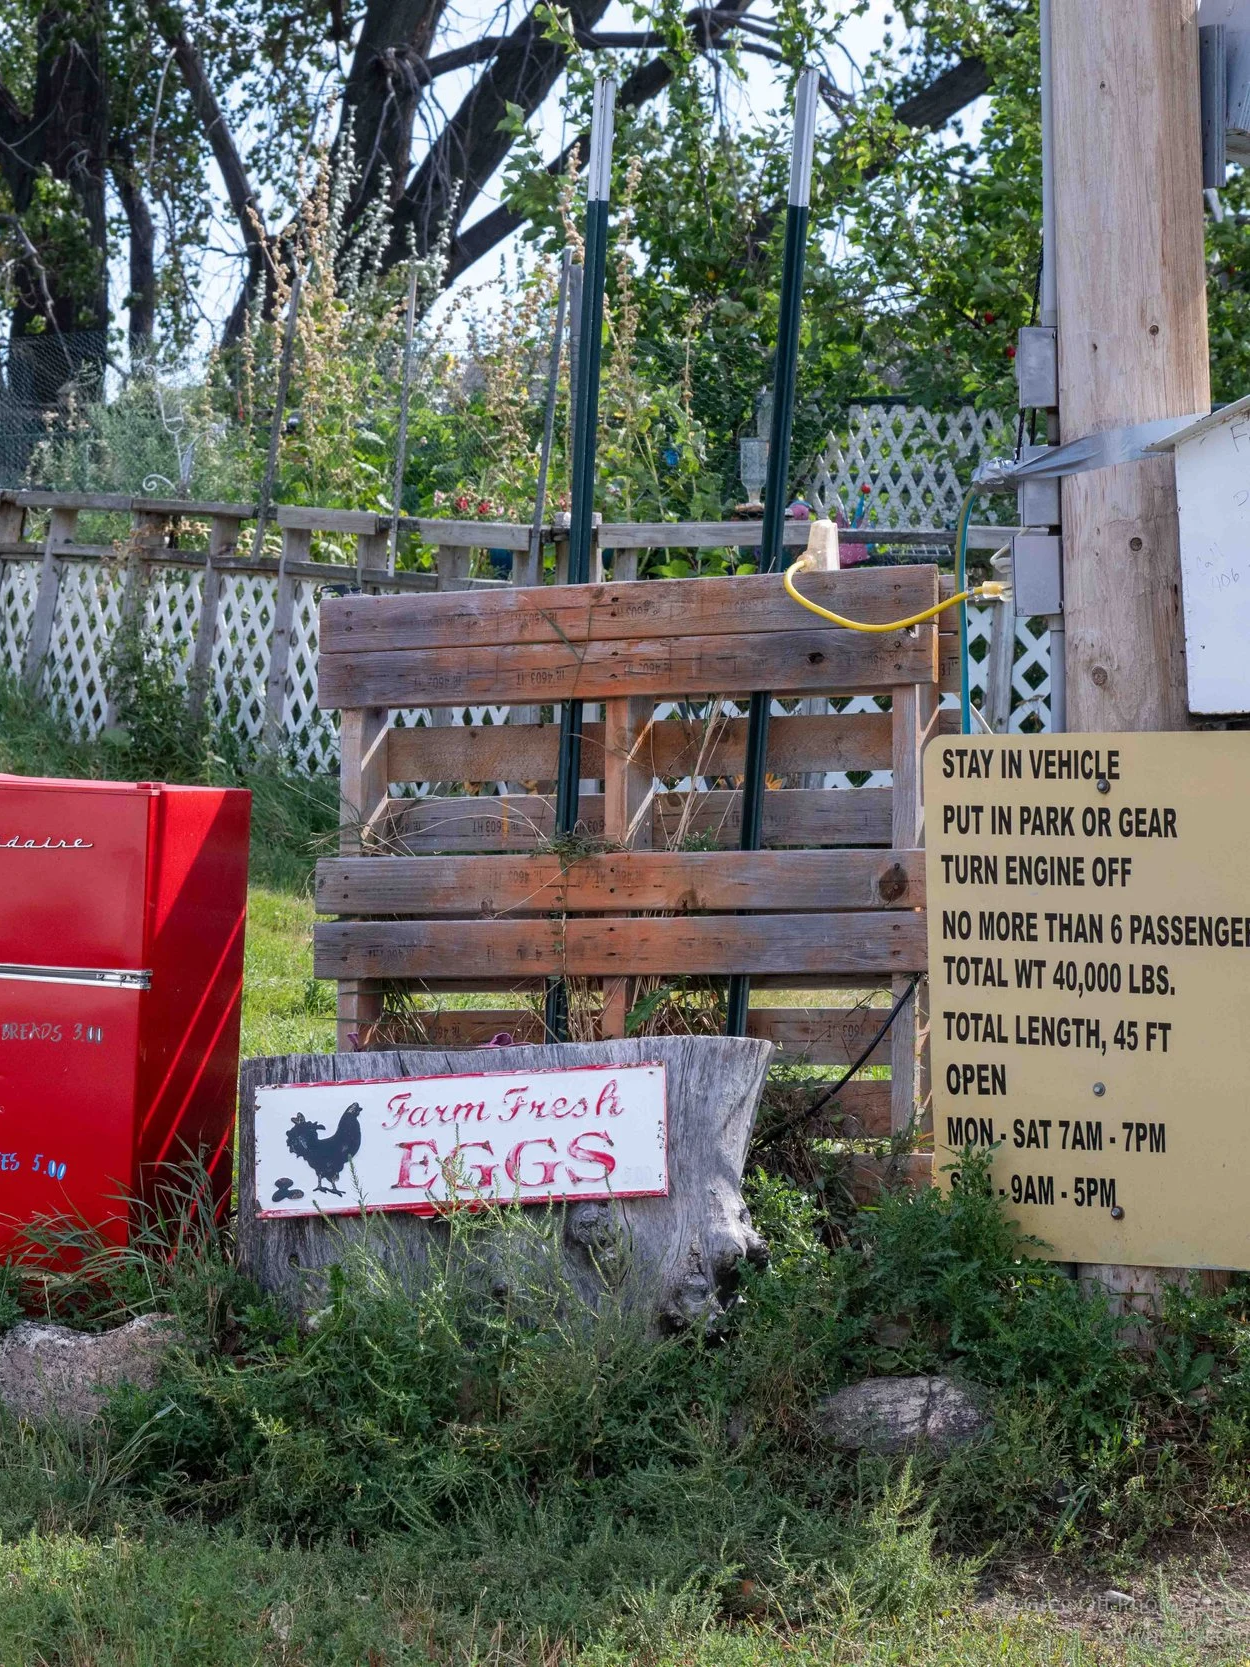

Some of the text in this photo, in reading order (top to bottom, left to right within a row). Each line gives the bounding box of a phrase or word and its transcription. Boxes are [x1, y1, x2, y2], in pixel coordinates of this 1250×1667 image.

[942, 748, 1120, 780] STAY IN VEHICLE
[943, 804, 1178, 839] PUT IN PARK OR GEAR
[941, 854, 1132, 888] TURN ENGINE OFF
[942, 910, 972, 941] NO
[979, 911, 1039, 942] MORE
[1044, 912, 1104, 944] THAN
[1110, 913, 1123, 945] 6
[943, 955, 1176, 999] TOTAL WT 40,000 LBS.
[1, 1022, 62, 1042] BREADS
[943, 1011, 1172, 1057] TOTAL LENGTH, 45 FT
[946, 1063, 1007, 1096] OPEN
[381, 1078, 625, 1130] Farm Fresh
[947, 1116, 993, 1149] MON
[1012, 1118, 1052, 1150] SAT
[1058, 1119, 1103, 1152] 7AM
[1121, 1121, 1166, 1154] 7PM
[31, 1153, 67, 1181] 5.00
[390, 1129, 618, 1192] EGGS
[1011, 1173, 1055, 1205] 9AM
[1073, 1176, 1118, 1209] 5PM
